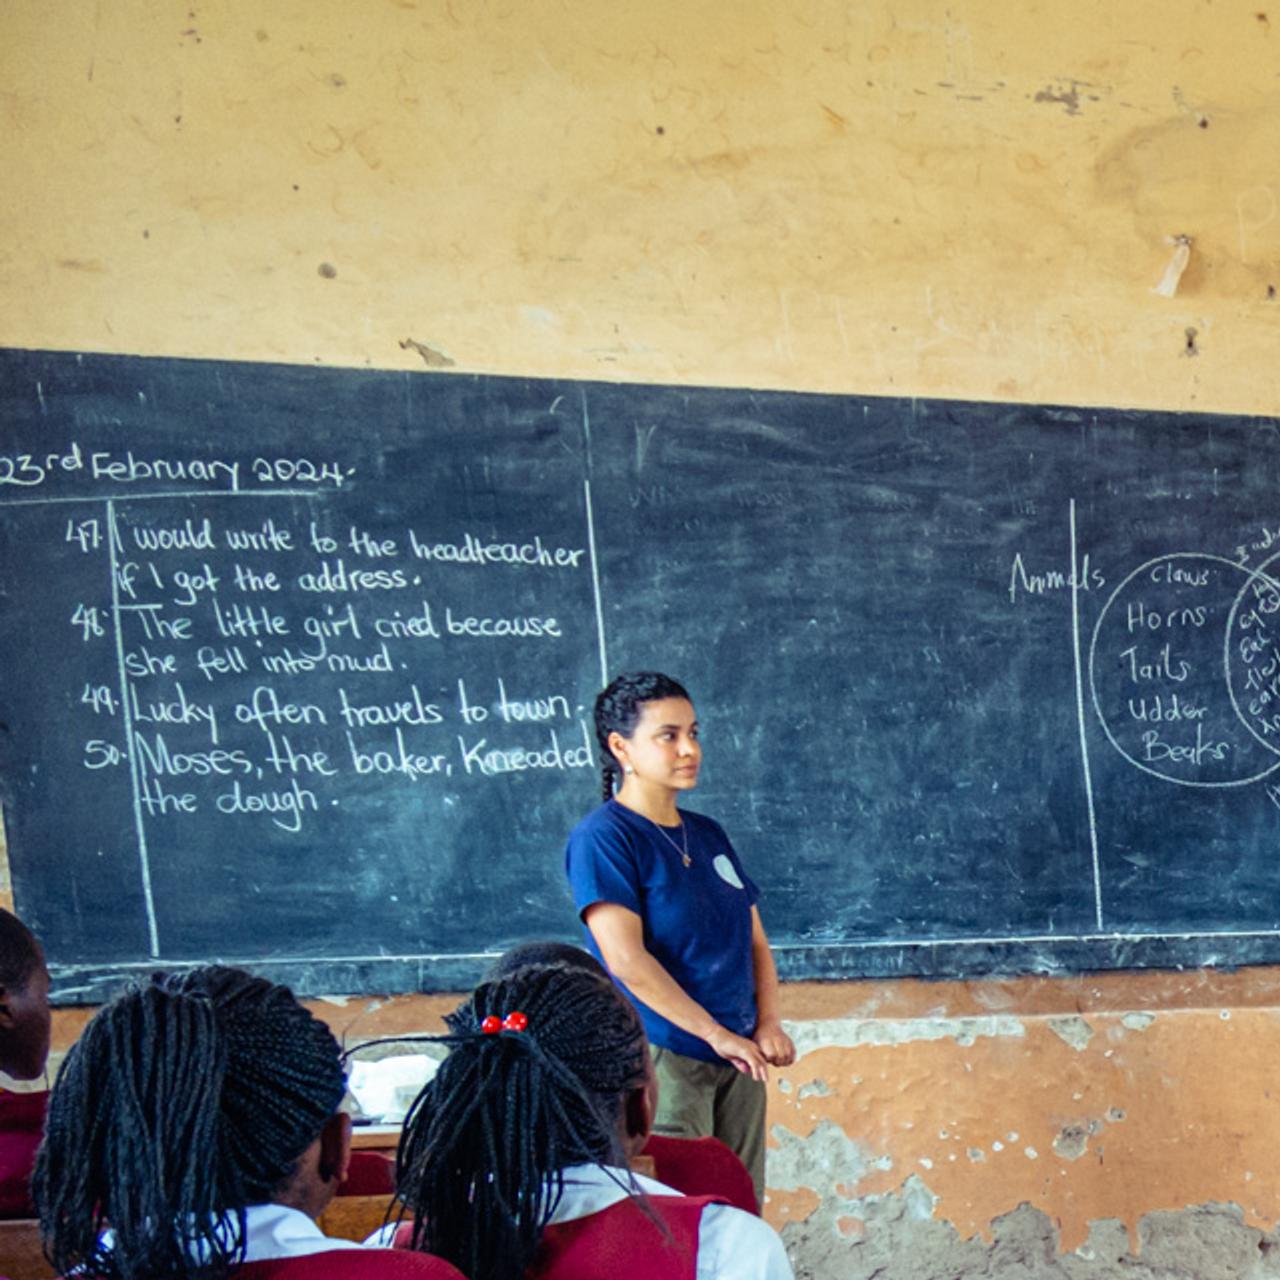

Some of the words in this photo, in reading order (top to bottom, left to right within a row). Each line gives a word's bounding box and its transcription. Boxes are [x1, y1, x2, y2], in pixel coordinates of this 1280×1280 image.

[91, 451, 239, 491] February
[134, 518, 215, 550] would
[226, 518, 294, 551] write
[311, 521, 337, 553] to
[350, 526, 397, 557] the
[409, 529, 585, 568] headteacher
[115, 562, 139, 599] if
[149, 562, 164, 589] I
[174, 564, 220, 605] got
[234, 564, 280, 591] the
[299, 559, 421, 592] address.
[1008, 552, 1106, 603] Animals
[116, 602, 193, 640] The
[213, 598, 290, 637] little
[302, 602, 361, 659] girl
[375, 600, 440, 638] cried
[447, 607, 562, 637] because
[198, 646, 248, 682] fell
[257, 640, 316, 675] into
[1120, 643, 1191, 683] Tails
[130, 682, 219, 744] Lucky
[236, 686, 328, 731] often
[339, 688, 443, 727] travels
[458, 678, 488, 724] to
[265, 731, 338, 774] the
[347, 727, 452, 781] baker,
[141, 778, 197, 816] the
